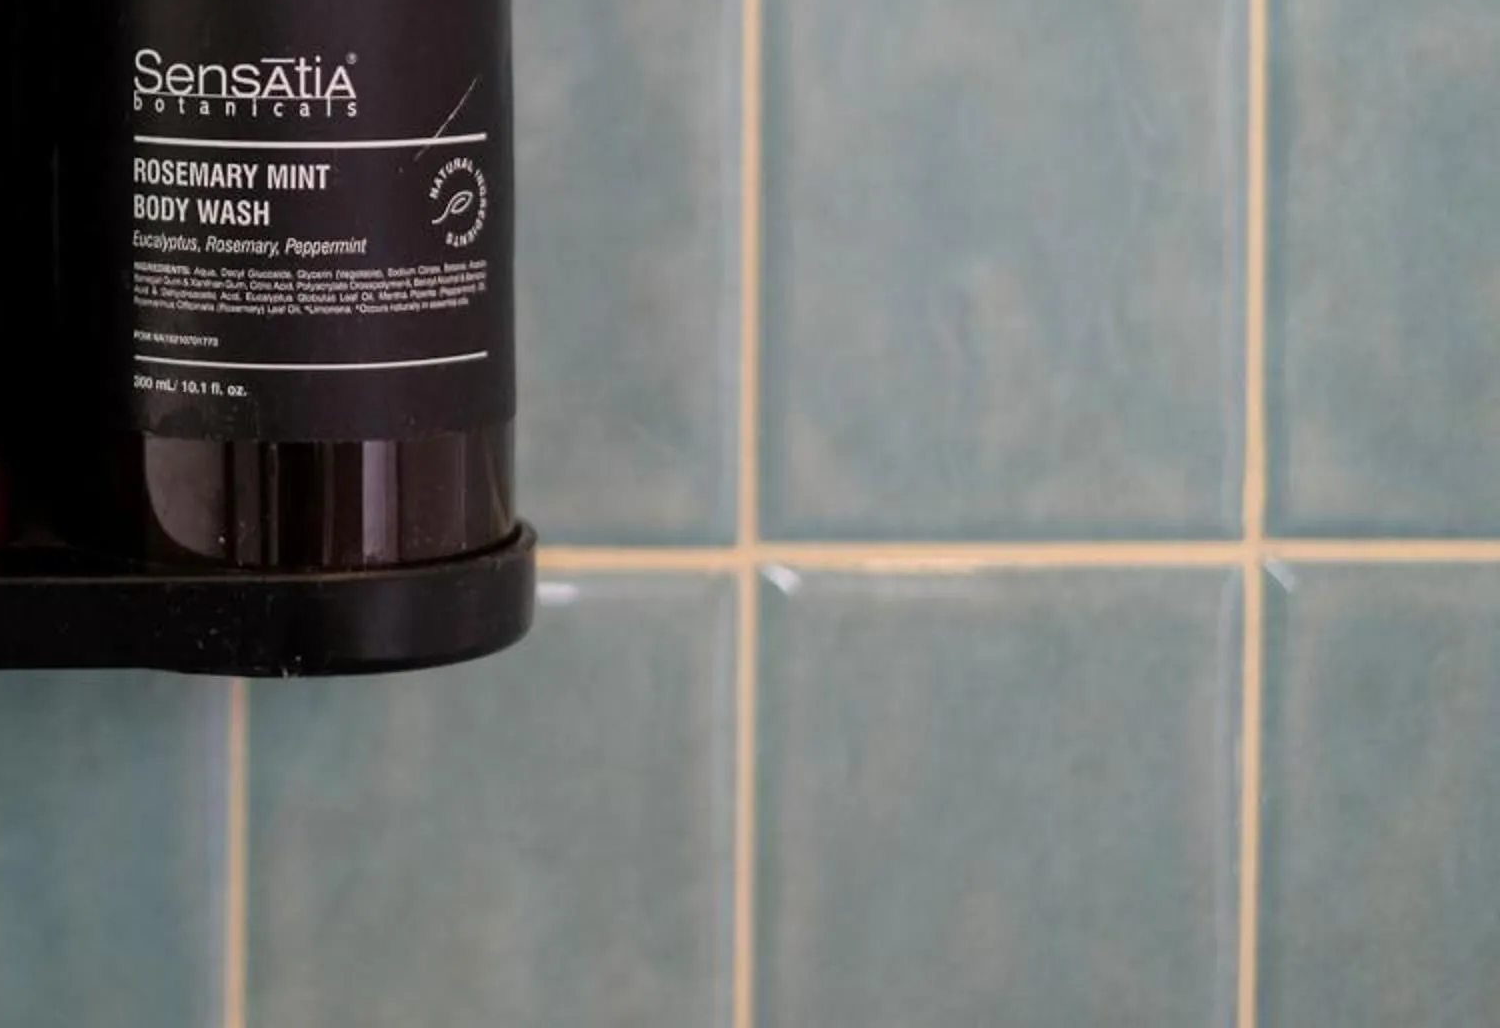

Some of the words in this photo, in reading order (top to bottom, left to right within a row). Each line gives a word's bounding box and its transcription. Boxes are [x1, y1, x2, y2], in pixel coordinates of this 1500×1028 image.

[133, 90, 358, 117] botanicals
[133, 157, 258, 190] ROSEMARY
[267, 164, 330, 190] MINT
[429, 156, 474, 201] NATURAL
[133, 195, 190, 224] BODY
[197, 200, 271, 227] WASH
[132, 230, 201, 254] Eucalyptus,
[205, 235, 280, 258] Rosemary,
[285, 236, 368, 258] Peppermint
[133, 375, 153, 389] 300
[181, 380, 207, 394] 10.1
[227, 384, 248, 397] oz.
